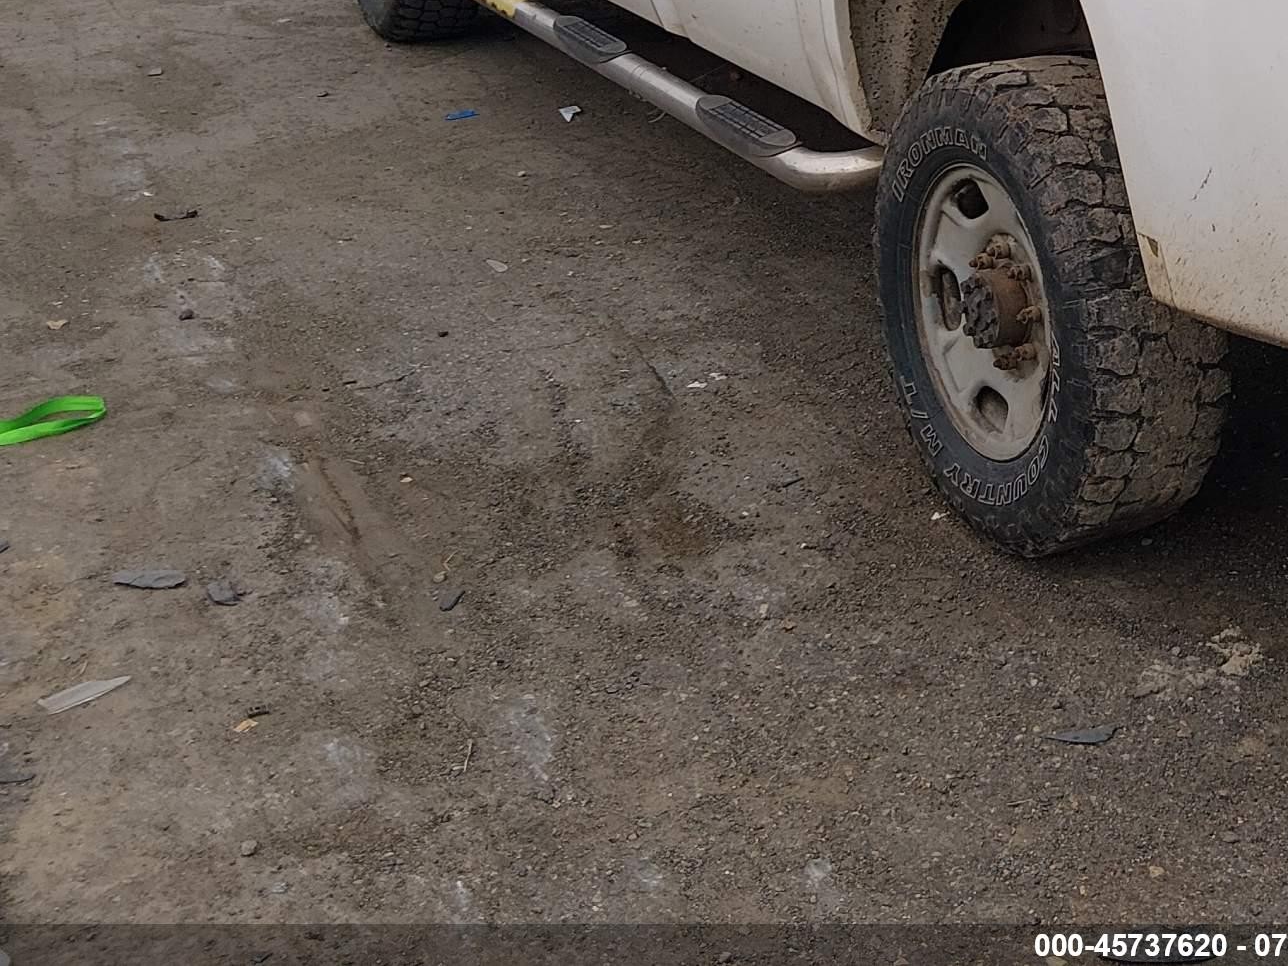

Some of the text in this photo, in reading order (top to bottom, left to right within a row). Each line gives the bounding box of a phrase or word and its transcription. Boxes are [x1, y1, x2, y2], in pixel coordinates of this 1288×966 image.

[892, 126, 987, 203] IRONMAN
[900, 332, 1061, 506] ALL COUNTRY M/T
